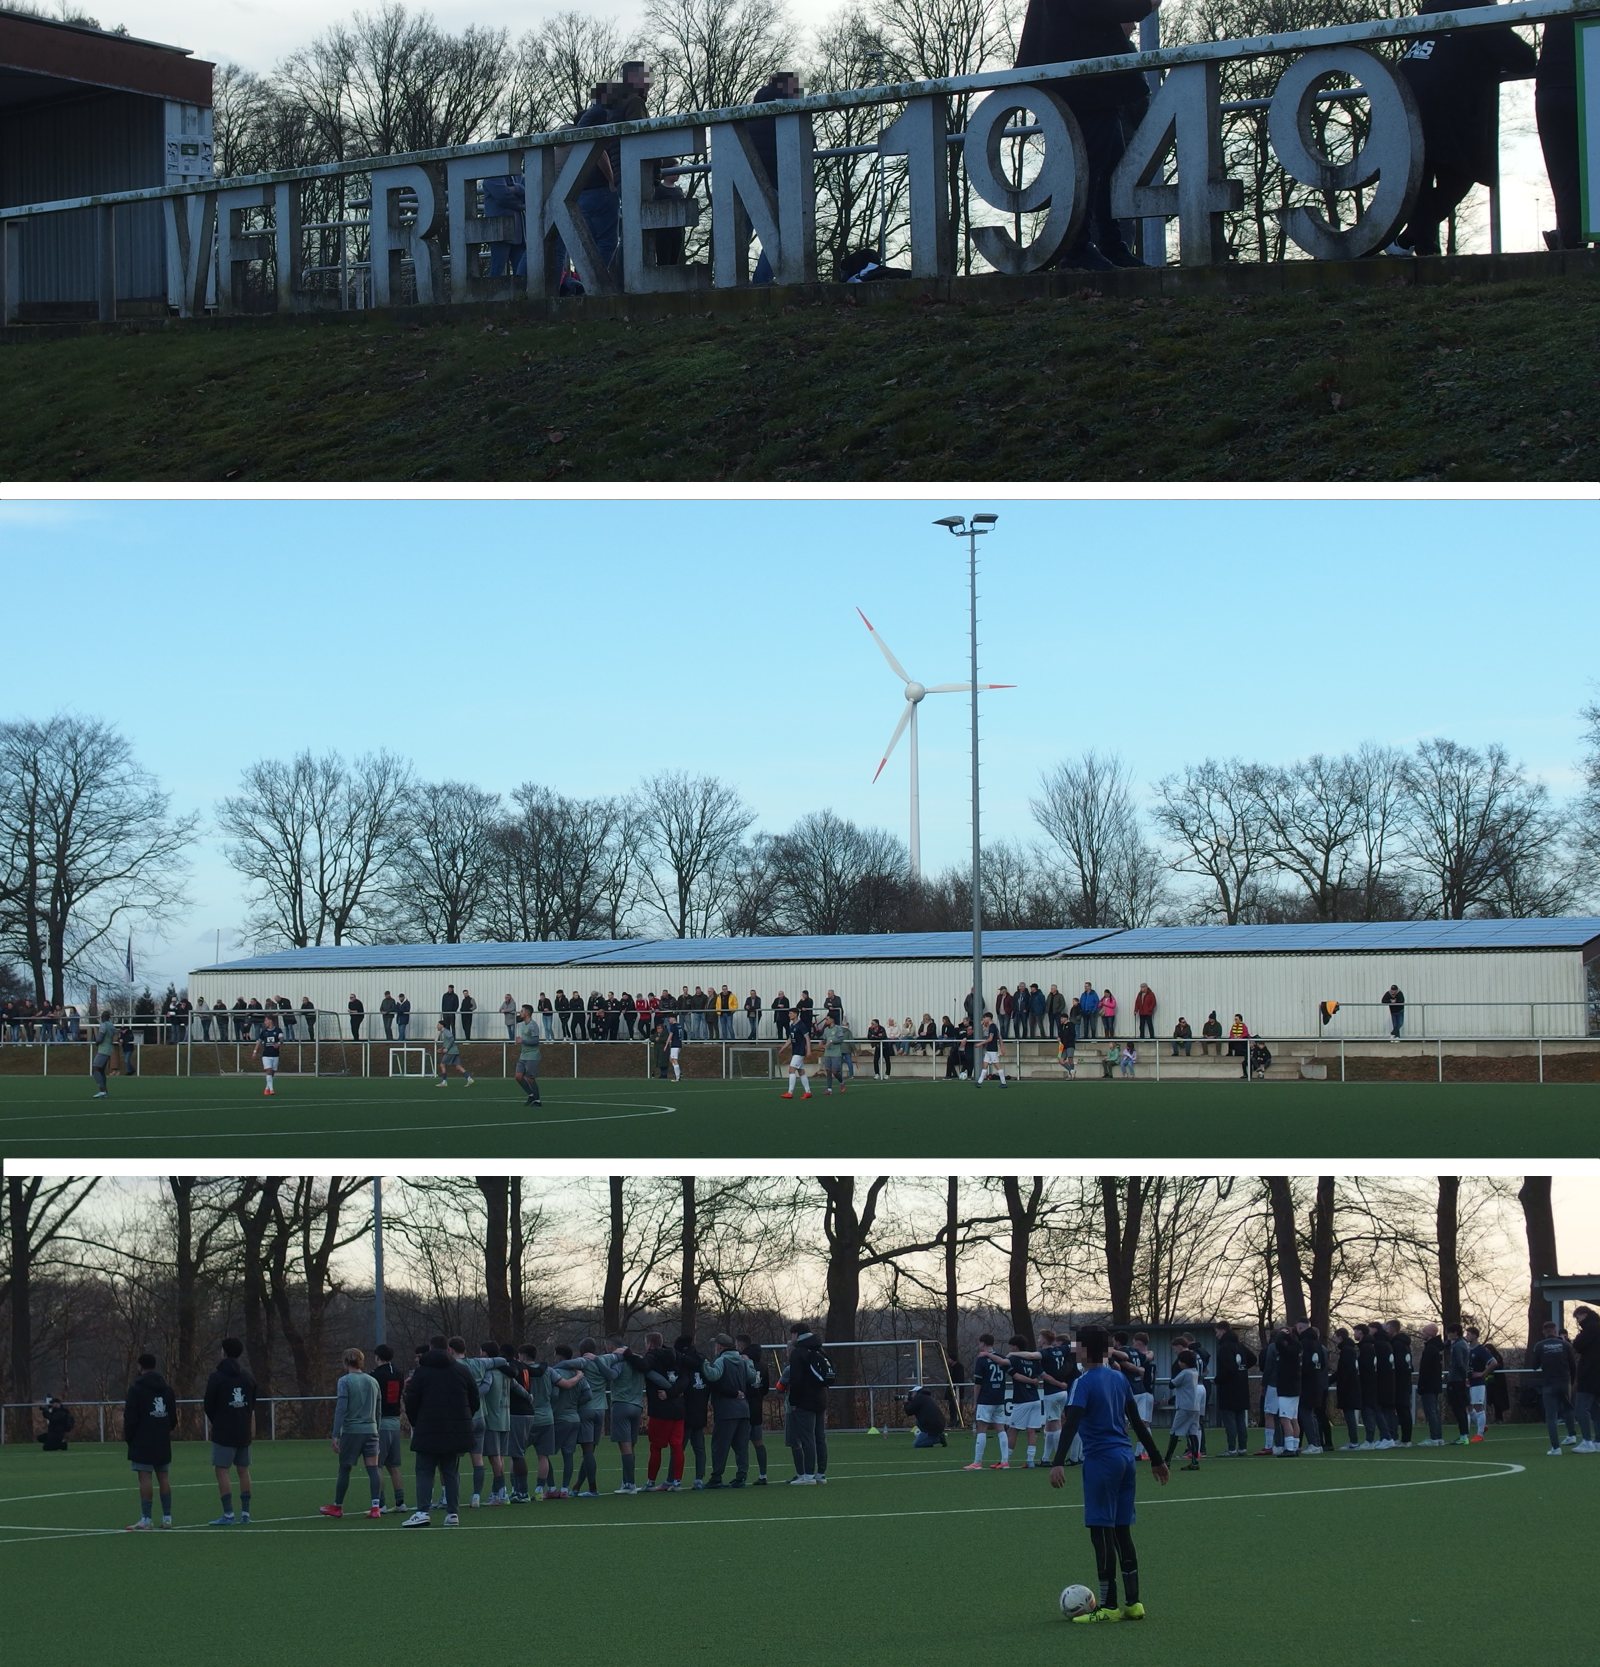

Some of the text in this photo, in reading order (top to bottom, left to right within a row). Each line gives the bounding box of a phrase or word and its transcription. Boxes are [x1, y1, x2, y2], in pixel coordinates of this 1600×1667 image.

[371, 113, 817, 306] REKEN
[878, 45, 1425, 278] 1949
[989, 1363, 1004, 1382] 25
